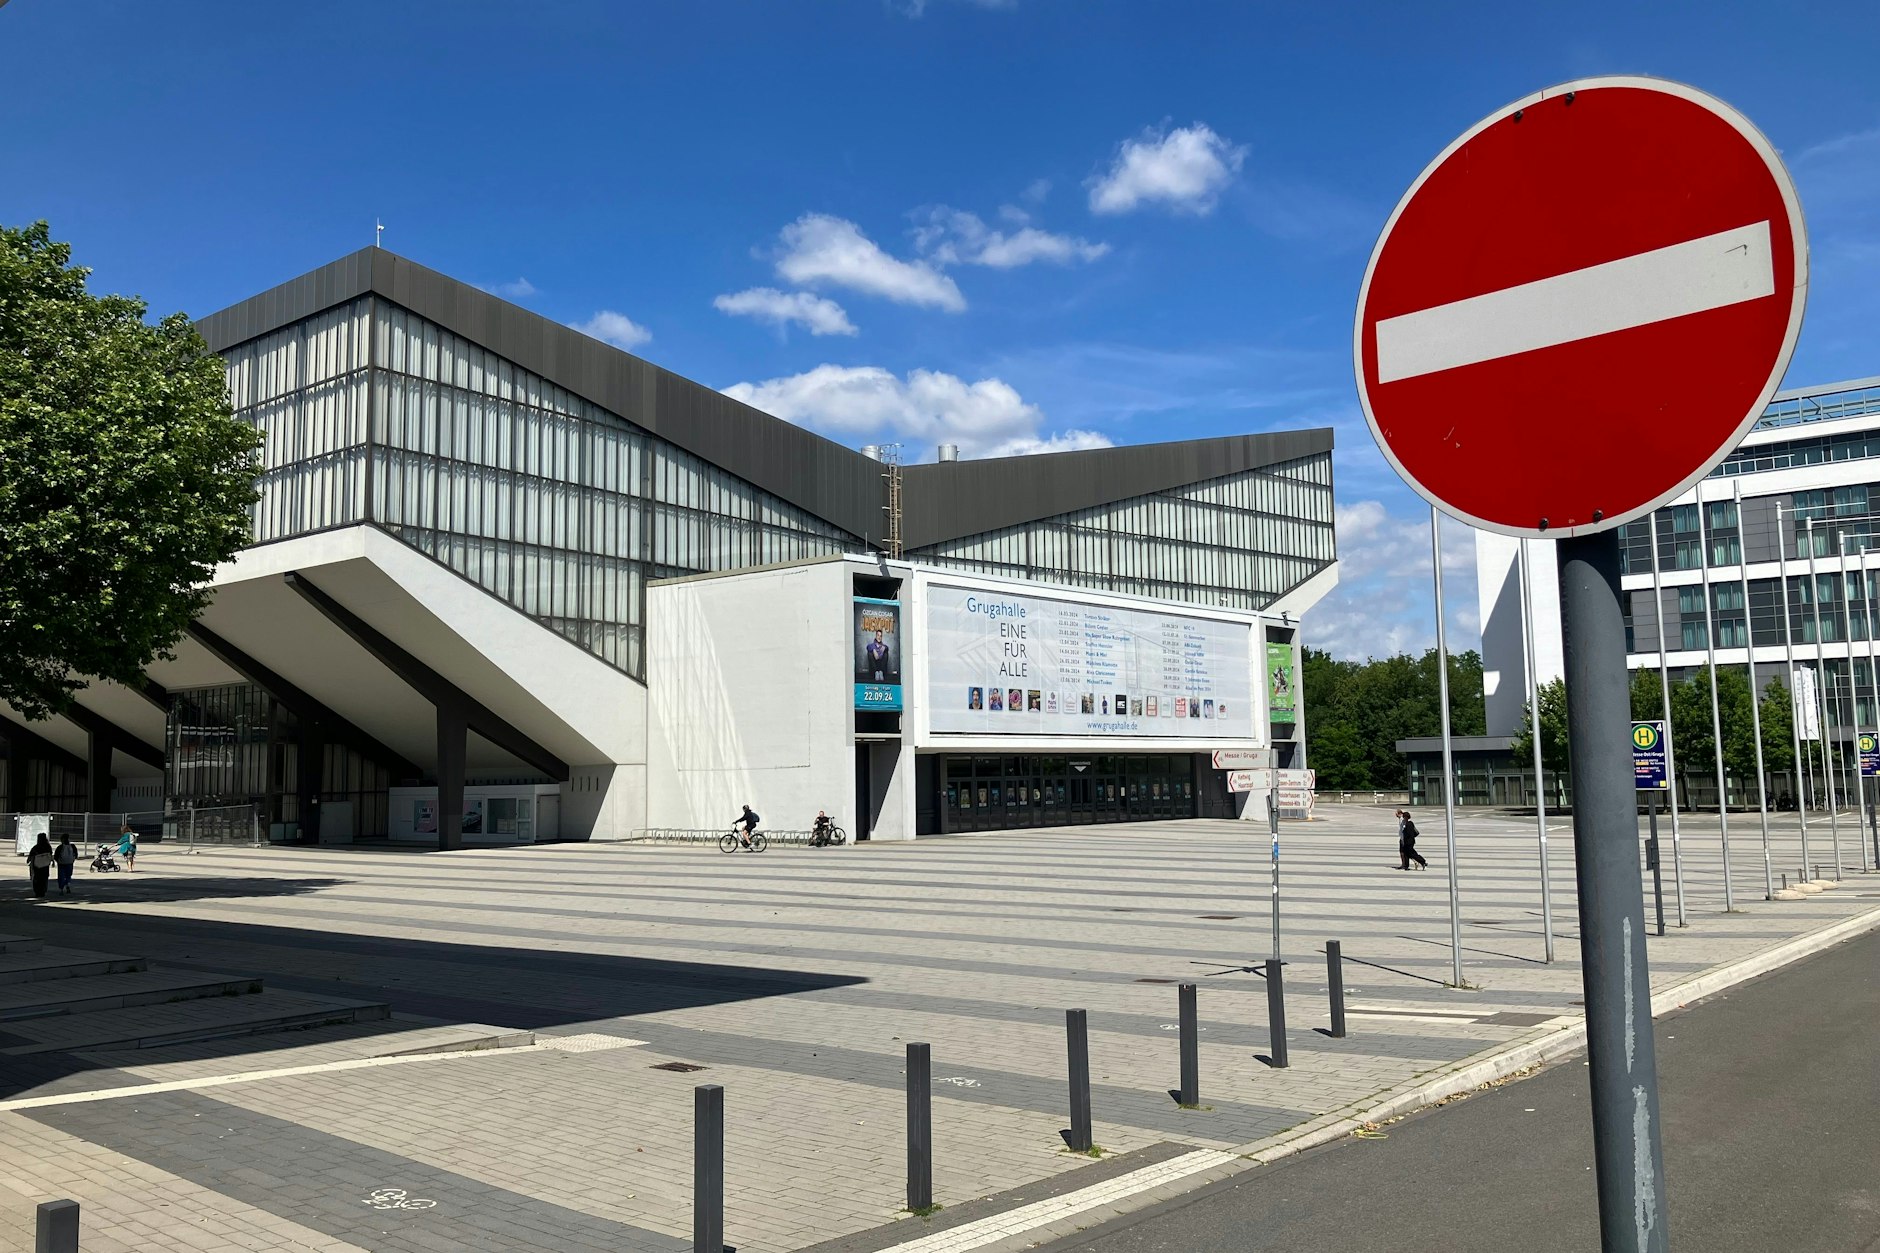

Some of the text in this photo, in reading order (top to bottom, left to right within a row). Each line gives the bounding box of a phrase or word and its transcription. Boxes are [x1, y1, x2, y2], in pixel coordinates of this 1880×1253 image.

[966, 597, 1026, 619] Grugahalle
[862, 616, 895, 634] JACKPOT
[1000, 622, 1026, 640] EINE
[1004, 640, 1027, 658] FÜR
[1000, 662, 1028, 678] ALLE
[864, 692, 892, 701] 22.09.24
[1087, 721, 1138, 731] www.grugahalle.de
[1656, 723, 1662, 732] 4
[1638, 730, 1650, 744] H
[1862, 738, 1870, 748] H
